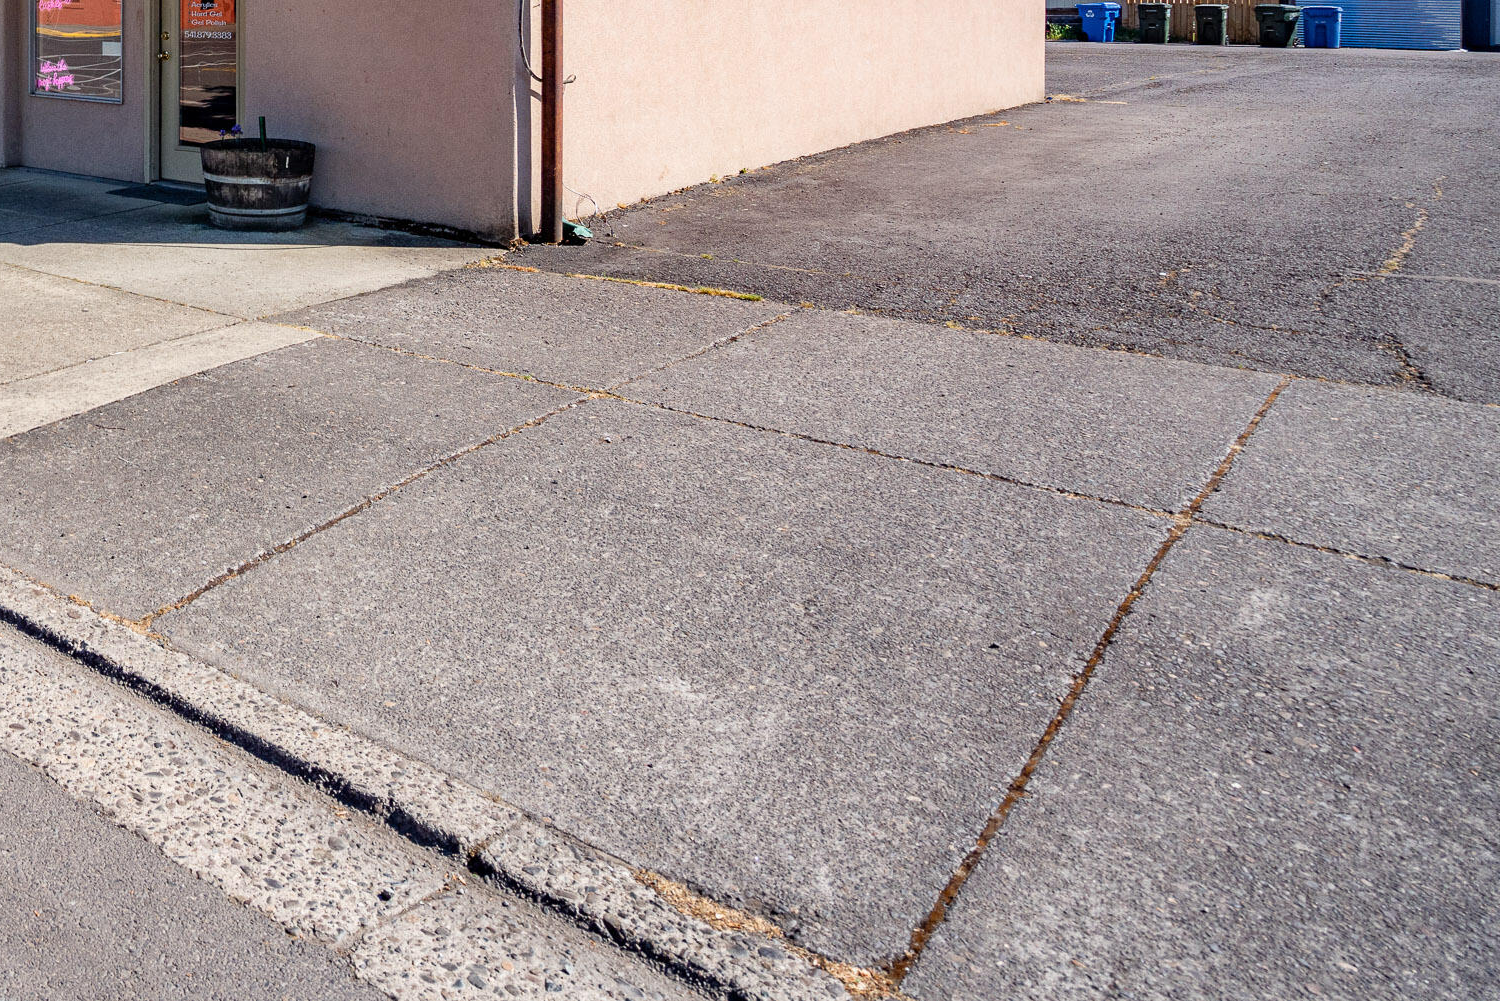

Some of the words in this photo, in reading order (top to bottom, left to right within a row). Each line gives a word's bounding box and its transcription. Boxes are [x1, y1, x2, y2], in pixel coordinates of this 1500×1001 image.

[191, 1, 219, 10] Acrylics
[191, 10, 208, 18] Hard
[209, 10, 223, 18] Gel
